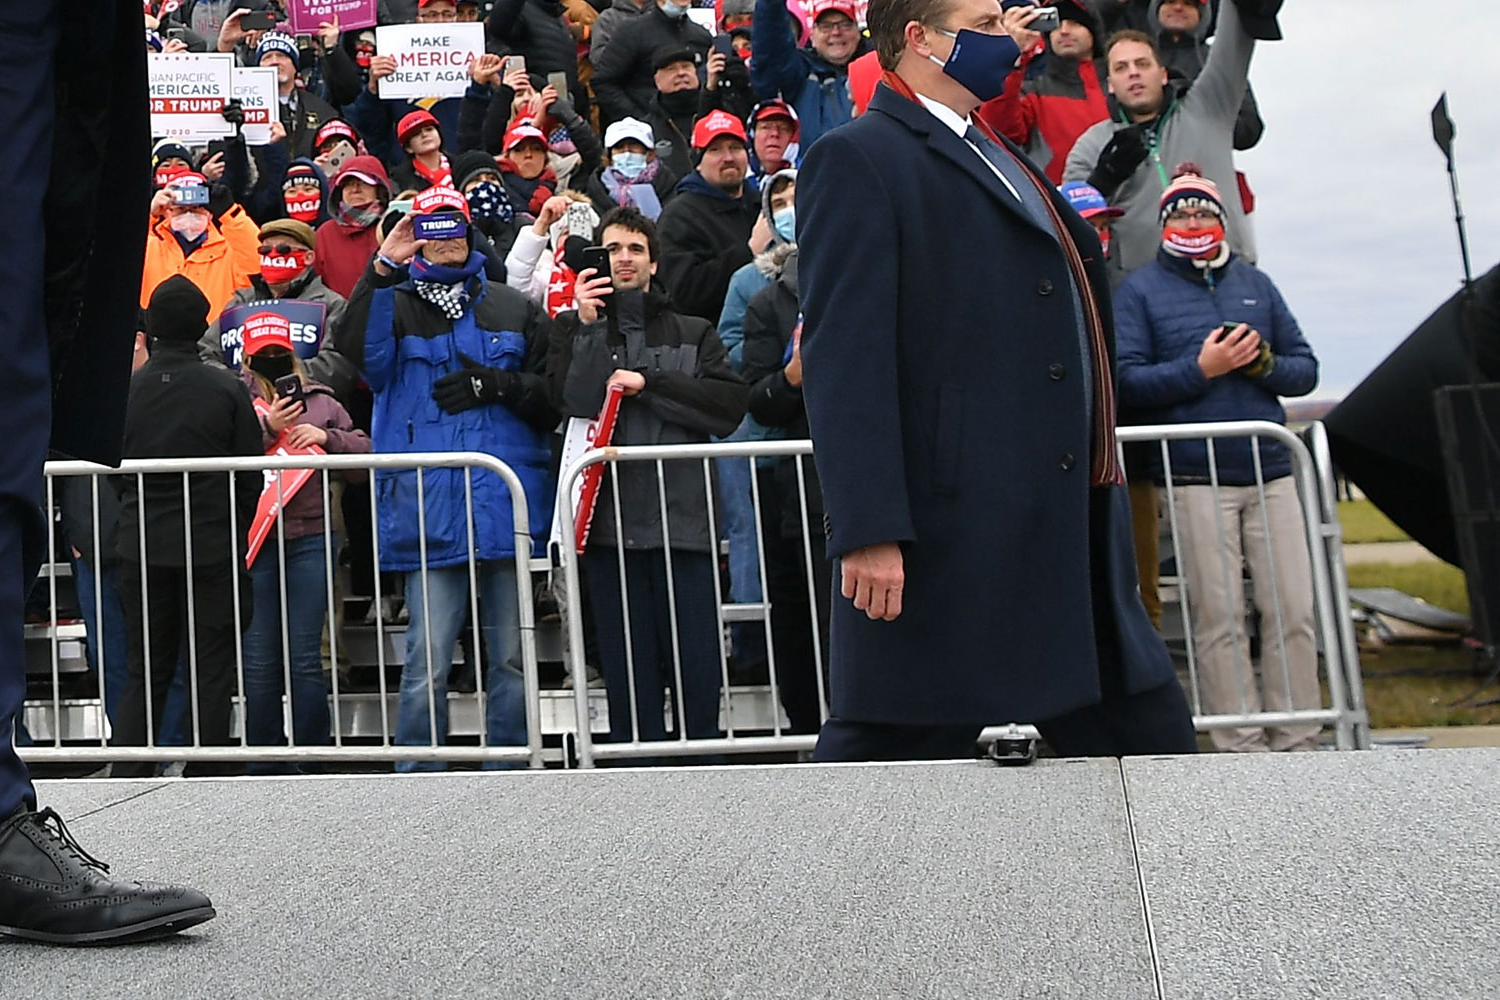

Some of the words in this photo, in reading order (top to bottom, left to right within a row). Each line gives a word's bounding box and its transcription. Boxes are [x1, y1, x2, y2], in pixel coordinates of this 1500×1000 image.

[310, 5, 331, 16] FOR
[333, 1, 361, 13] TRUMP
[411, 36, 450, 47] MAKE
[150, 73, 173, 82] SIAN
[176, 72, 215, 82] PACIFIC
[149, 84, 220, 95] MERICANS
[234, 86, 259, 95] CIFIC
[170, 99, 222, 112] TRUMP
